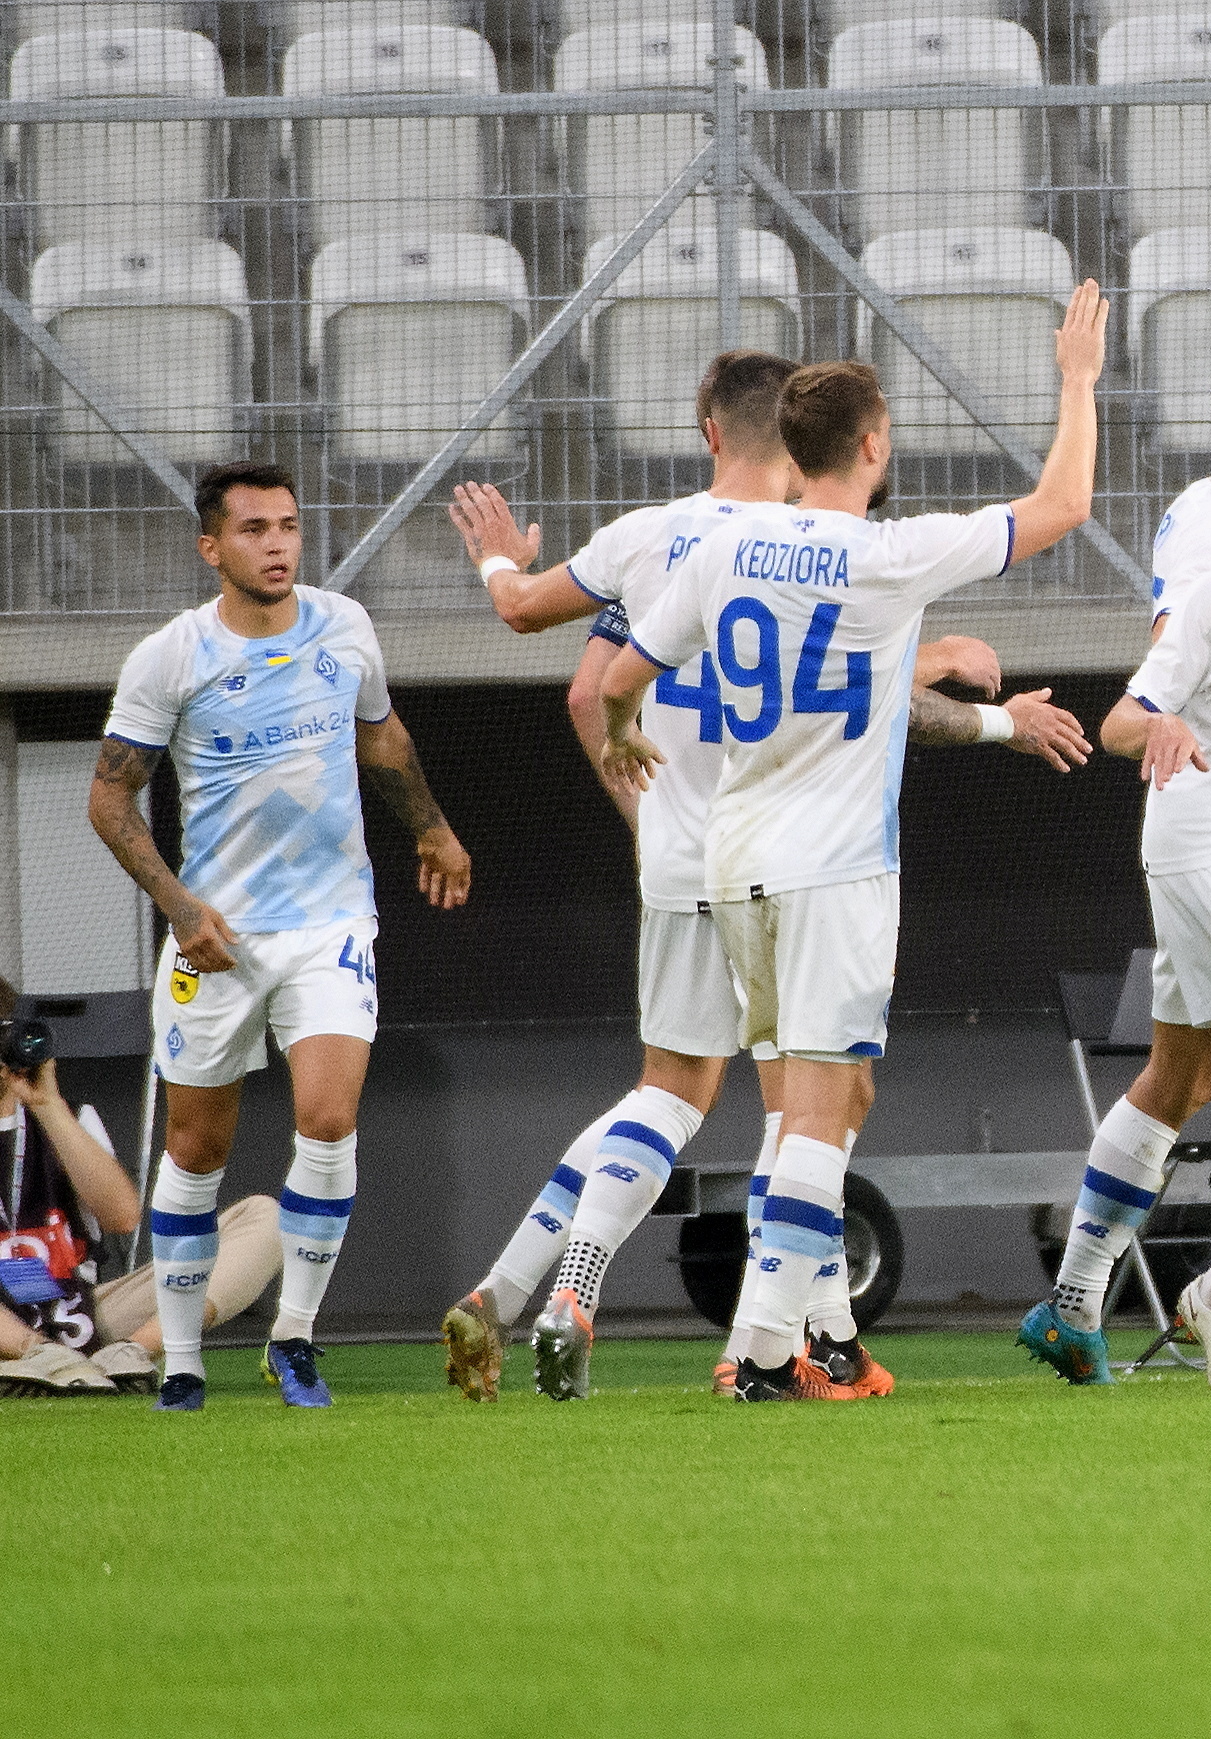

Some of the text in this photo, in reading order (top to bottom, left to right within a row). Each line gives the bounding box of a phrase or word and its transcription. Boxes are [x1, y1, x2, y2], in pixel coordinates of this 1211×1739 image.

[733, 538, 849, 588] KEDZIORA
[655, 649, 723, 744] 4
[717, 596, 872, 743] 94
